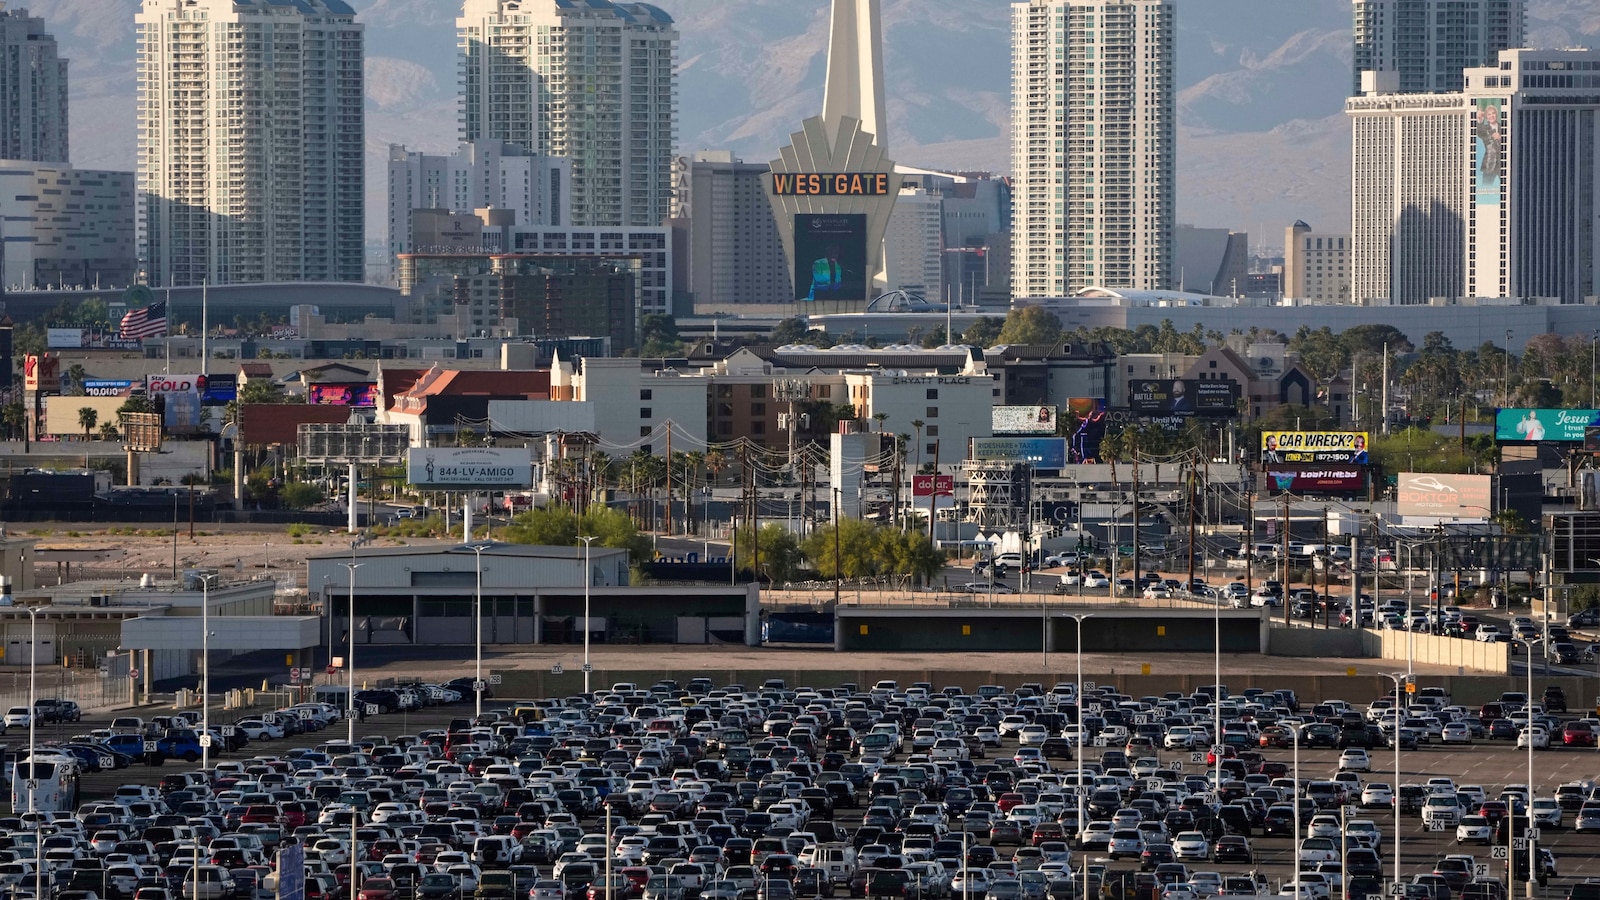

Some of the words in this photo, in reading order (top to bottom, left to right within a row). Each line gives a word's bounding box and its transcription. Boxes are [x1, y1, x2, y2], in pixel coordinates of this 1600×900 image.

[774, 174, 886, 194] WESTGATE
[150, 381, 191, 392] GOLD
[1555, 410, 1590, 426] Jesus
[1279, 434, 1302, 446] CAR
[1306, 434, 1354, 447] WRECK?
[440, 468, 514, 476] 844-LV-AMIGO
[918, 478, 947, 489] dolar.
[1400, 492, 1458, 503] BOKTOR
[1117, 728, 1126, 736] 2U
[145, 742, 155, 751] 2R
[1096, 738, 1104, 746] 2T
[1213, 745, 1223, 754] 2S
[101, 758, 112, 766] 2Q
[1171, 762, 1182, 770] 2Q
[60, 765, 70, 774] 2P
[27, 781, 37, 789] 2N
[1149, 782, 1158, 790] 2P
[1076, 787, 1086, 795] 2N
[1206, 795, 1216, 803] 2M
[1431, 821, 1443, 830] 2K
[1528, 830, 1538, 839] 2J
[1513, 839, 1523, 848] 2H
[1494, 848, 1506, 857] 2G
[1476, 865, 1487, 875] 2F
[1392, 884, 1403, 894] 2E
